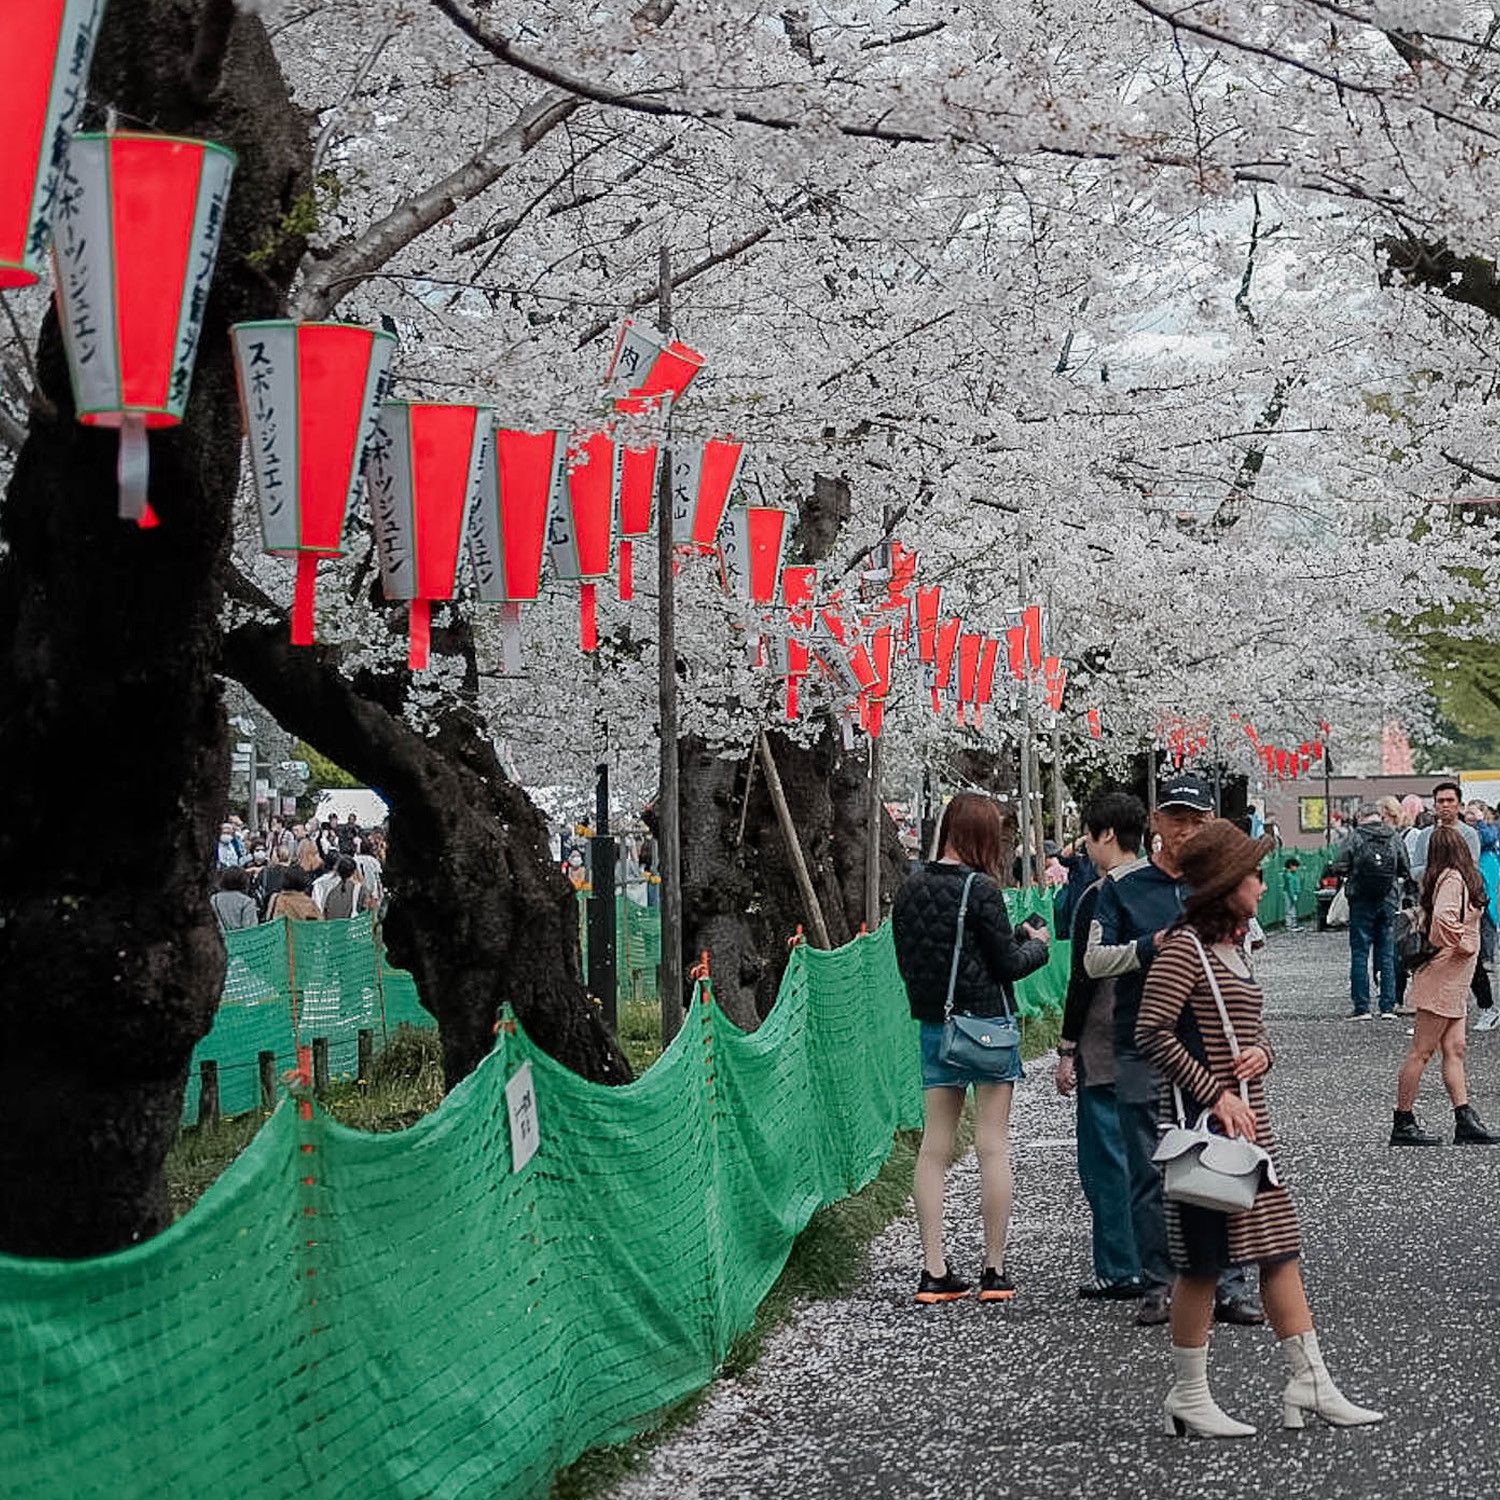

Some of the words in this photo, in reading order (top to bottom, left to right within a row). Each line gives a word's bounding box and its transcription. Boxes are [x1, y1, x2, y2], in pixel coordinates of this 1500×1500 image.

[249, 342, 283, 516] スポーツジュエン
